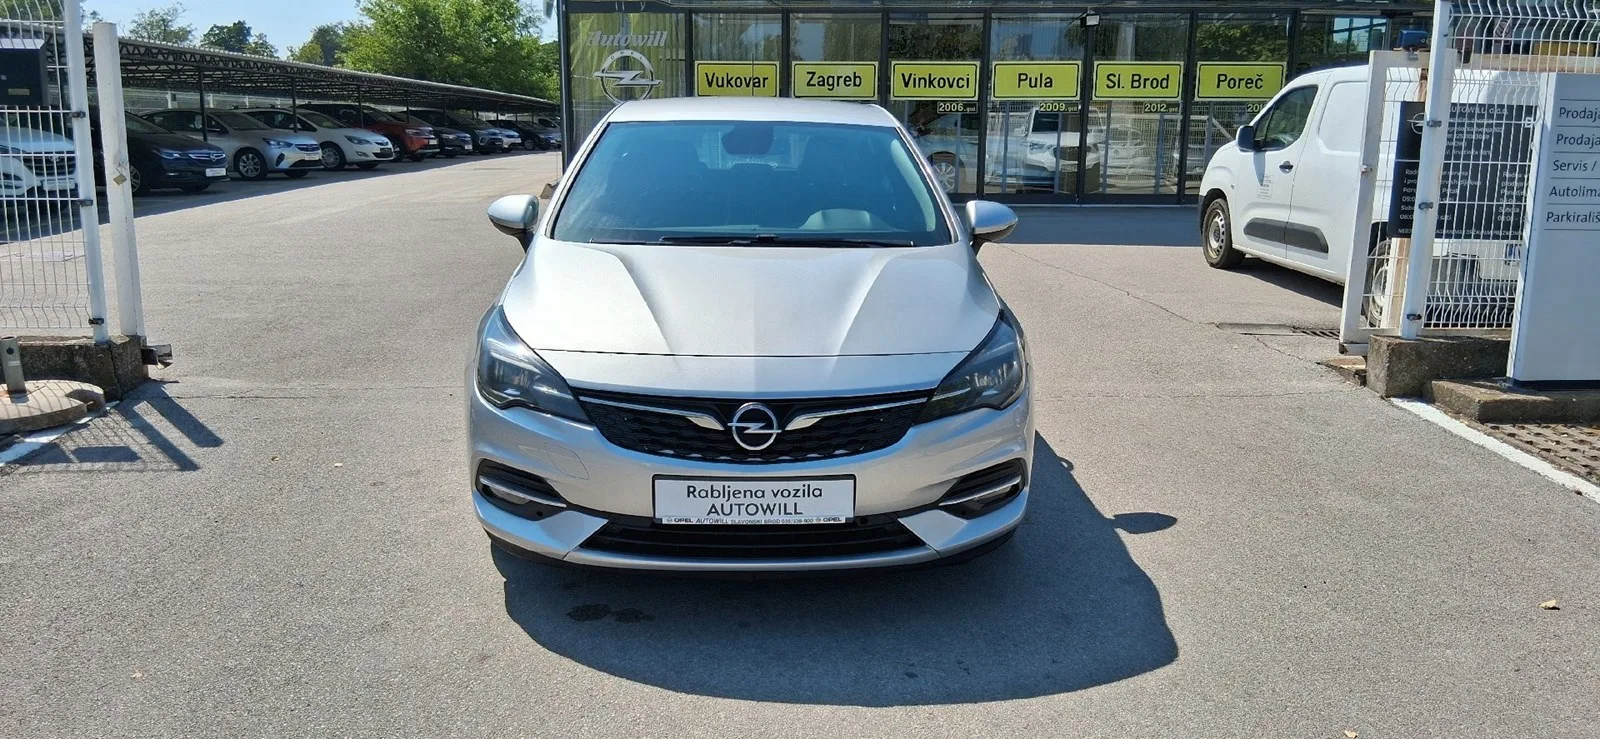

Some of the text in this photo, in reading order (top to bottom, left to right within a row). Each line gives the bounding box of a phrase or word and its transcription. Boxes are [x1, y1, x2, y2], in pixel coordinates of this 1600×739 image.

[587, 30, 668, 48] Autowill
[705, 72, 769, 88] Vukovar
[806, 71, 862, 92] Zagreb
[901, 72, 970, 89] Vinkovci
[1018, 73, 1053, 89] Pula
[1106, 73, 1169, 90] Sl. Brod
[1217, 73, 1264, 90] Poreč
[1556, 133, 1600, 149] Prodaja
[1553, 159, 1588, 172] Servis
[687, 484, 823, 502] Rabljena vozila
[706, 502, 804, 517] AUTOWILL
[695, 517, 728, 525] AUTOWILL
